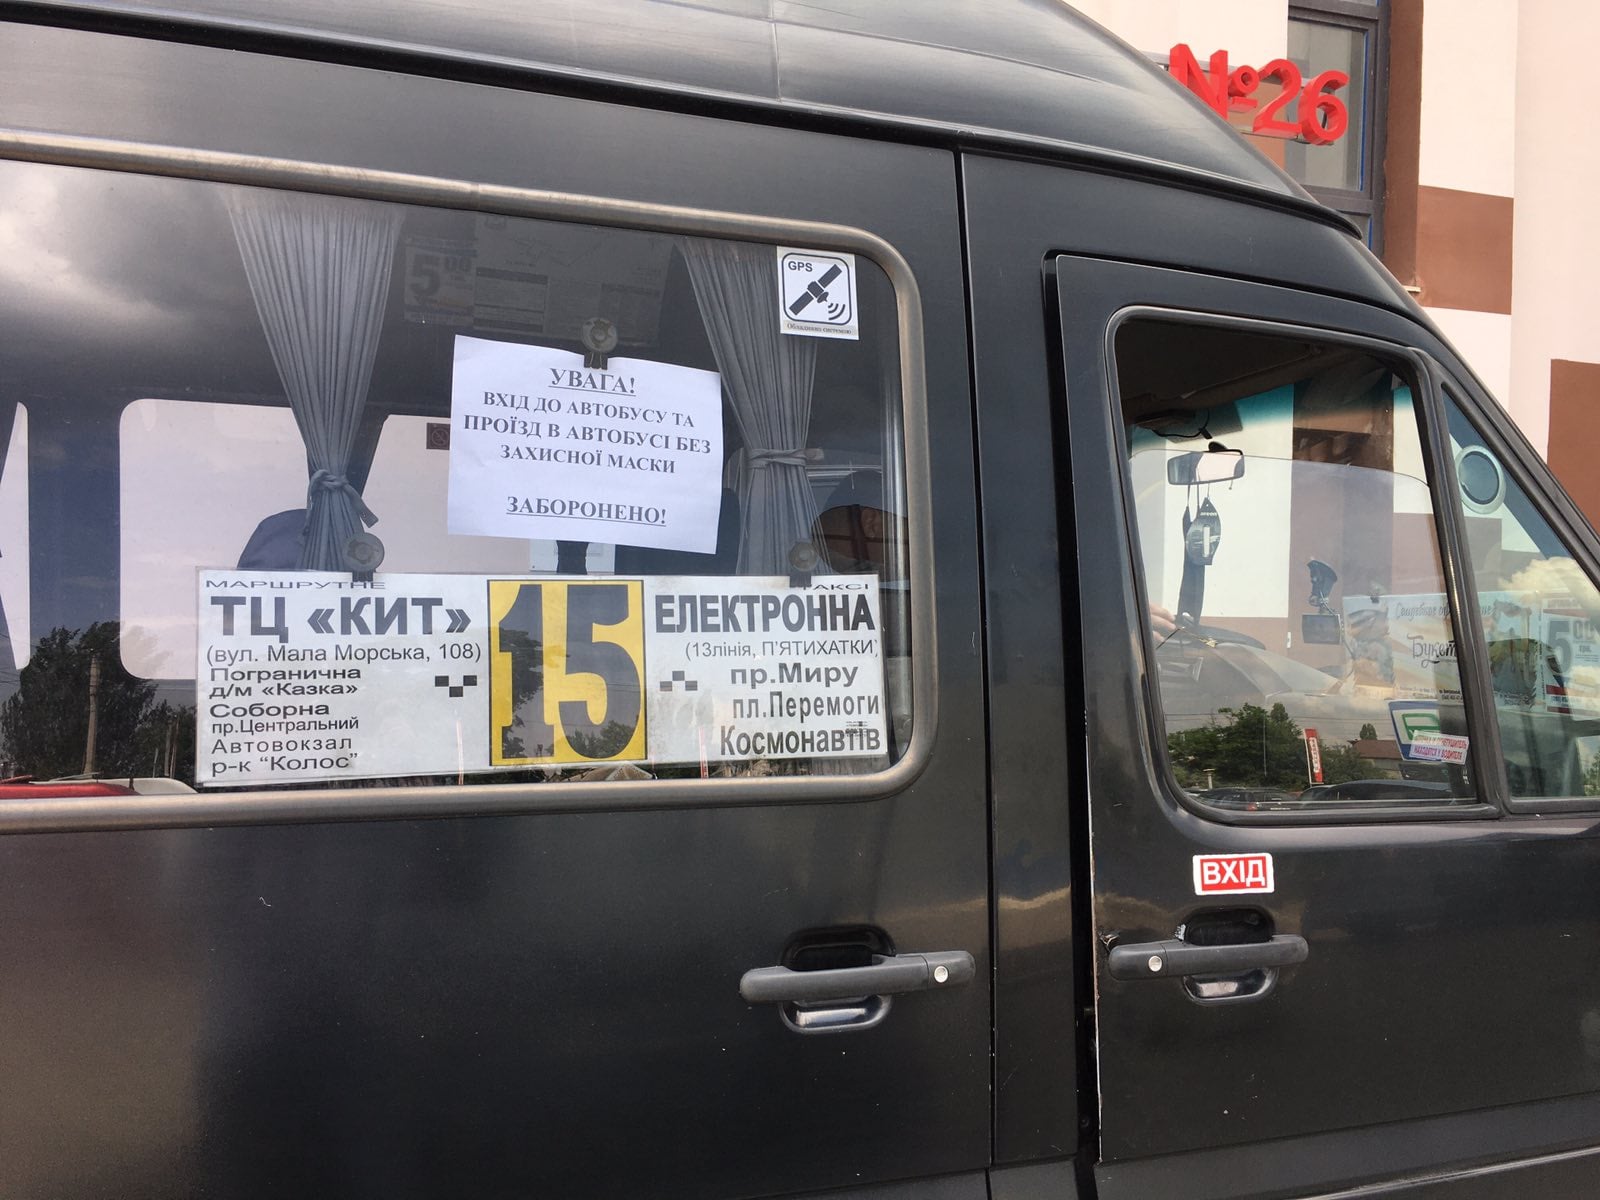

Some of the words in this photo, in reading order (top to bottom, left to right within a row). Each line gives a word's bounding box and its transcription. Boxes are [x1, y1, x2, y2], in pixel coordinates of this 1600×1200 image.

[788, 260, 813, 272] GPS
[550, 367, 636, 395] УВАГА!
[483, 391, 530, 411] ВХІД
[534, 397, 562, 413] ДО
[567, 401, 667, 424] АВТОБУСУ
[672, 412, 695, 428] ТА
[463, 414, 542, 438] ПРОЇЗД
[548, 423, 561, 438] В
[566, 426, 670, 449] АВТОБУСІ
[676, 437, 711, 454] БЕЗ
[500, 444, 602, 466] ЗАХИСНОЇ
[607, 454, 675, 473] МАСКИ
[506, 496, 666, 526] ЗАБОРОНЕНО!
[206, 580, 385, 589] МАРШРУТНЕ
[211, 596, 289, 643] ТЦ
[307, 596, 472, 635] «КИТ»
[656, 594, 875, 633] ЕЛЕКТРОННА
[206, 645, 259, 666] (вул.
[267, 645, 327, 662] Мала
[335, 644, 431, 665] Морська,
[439, 643, 482, 663] 108)
[685, 641, 757, 661] (13лінія,
[210, 667, 361, 683] Погранична
[499, 584, 642, 760] 15
[730, 662, 859, 689] пр.Миру
[209, 685, 252, 699] д/м
[262, 683, 358, 696] «Казка»
[210, 702, 330, 718] Соборна
[733, 691, 880, 723] пл.Перемоги
[212, 717, 360, 737] пр.Центральний
[721, 725, 880, 756] Космонавтів
[211, 737, 353, 755] Автовокзал
[212, 760, 251, 777] р-к
[1202, 860, 1265, 887] ВХІД
